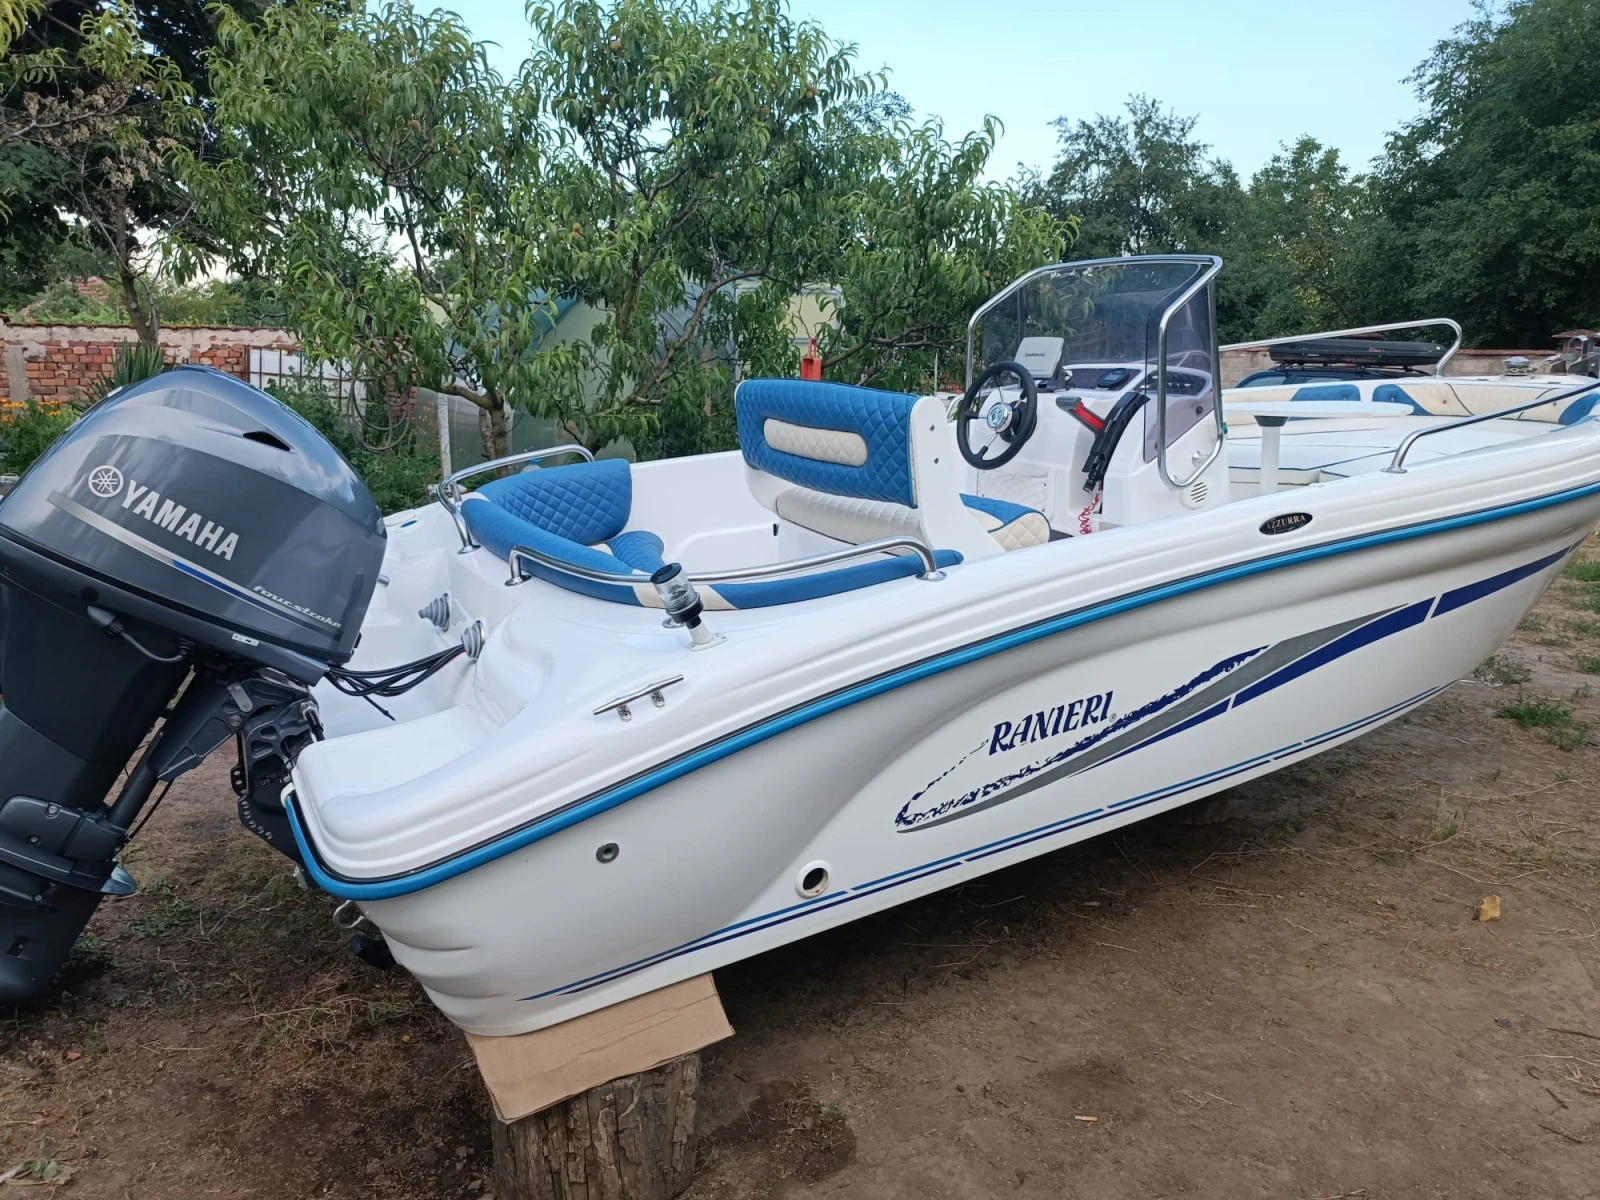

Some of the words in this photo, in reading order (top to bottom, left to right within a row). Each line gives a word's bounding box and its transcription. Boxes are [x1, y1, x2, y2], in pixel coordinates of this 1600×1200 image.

[121, 479, 240, 561] YAMAHA
[1265, 514, 1306, 530] AZZURRA
[252, 585, 342, 628] fourstroke
[988, 690, 1114, 756] RANIERI
